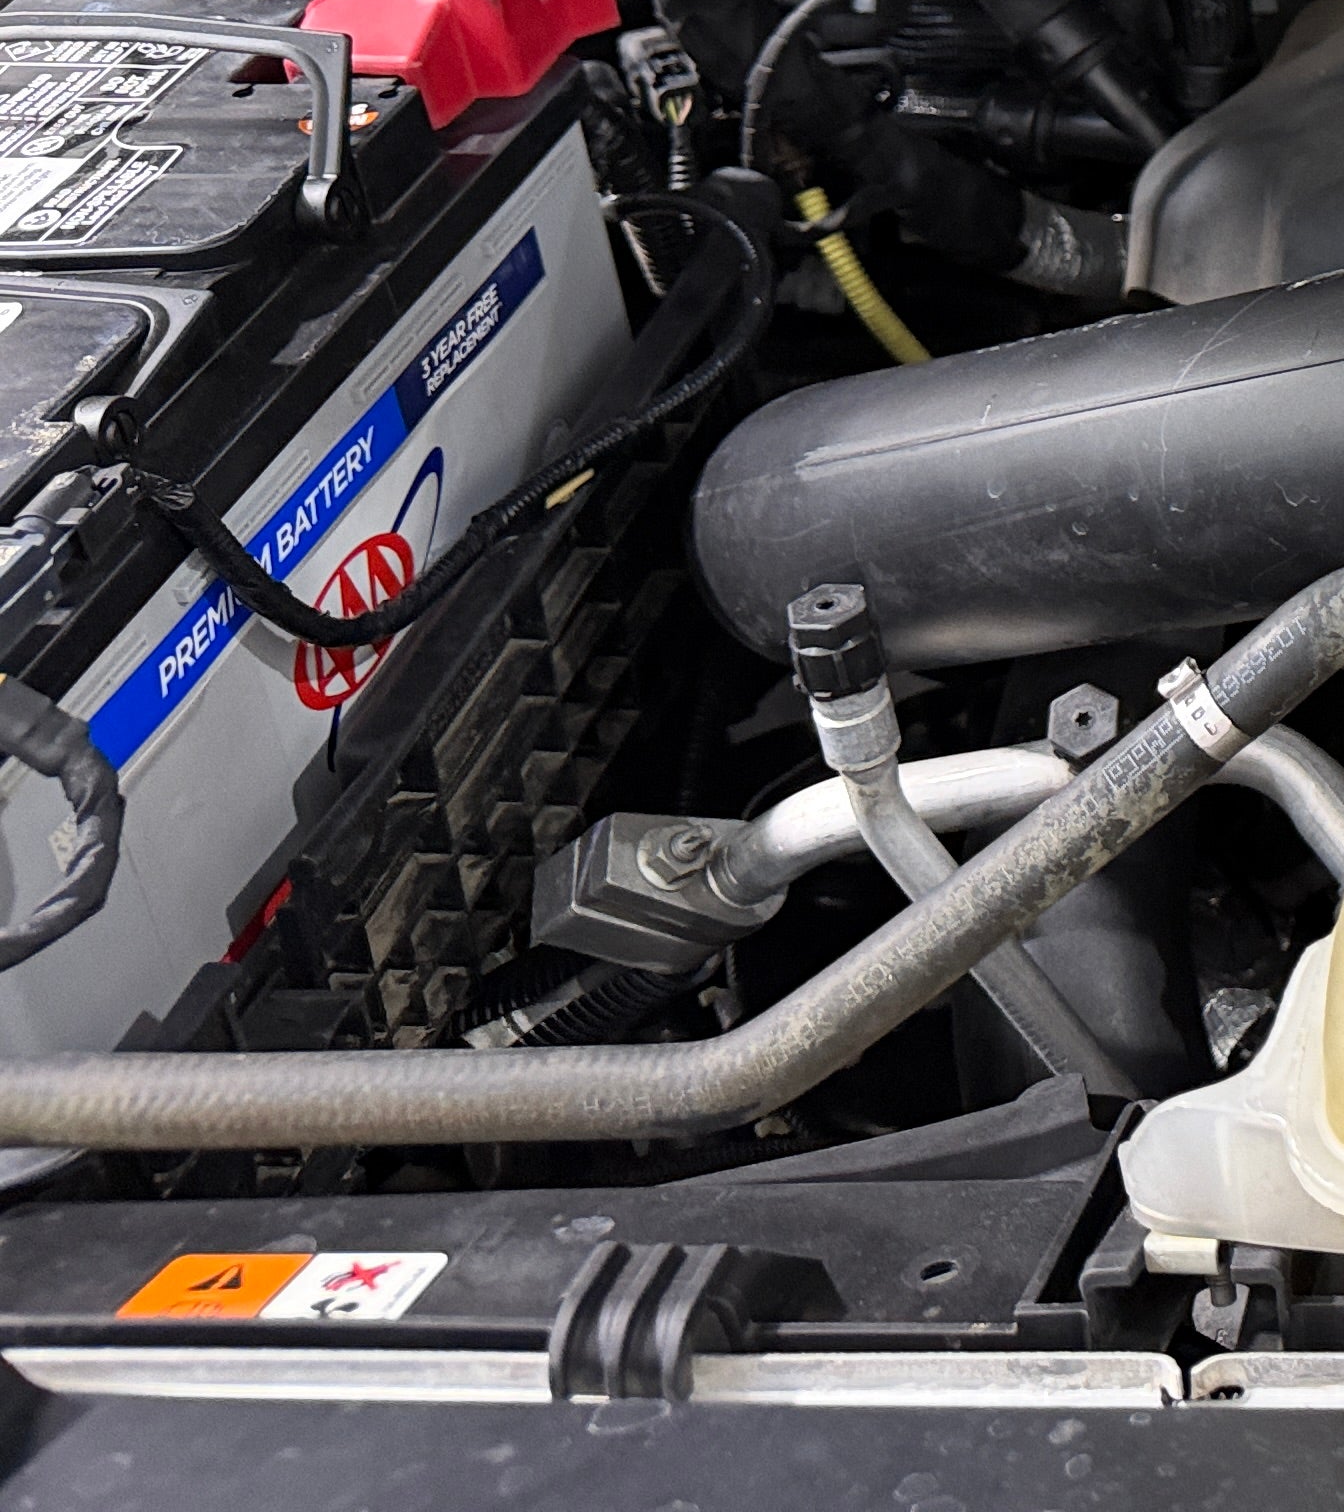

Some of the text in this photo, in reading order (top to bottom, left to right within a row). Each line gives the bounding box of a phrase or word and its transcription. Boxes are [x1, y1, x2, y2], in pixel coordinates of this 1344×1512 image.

[421, 283, 498, 379] 3 YEAR FREE
[158, 425, 375, 698] PREMIM BATTERY
